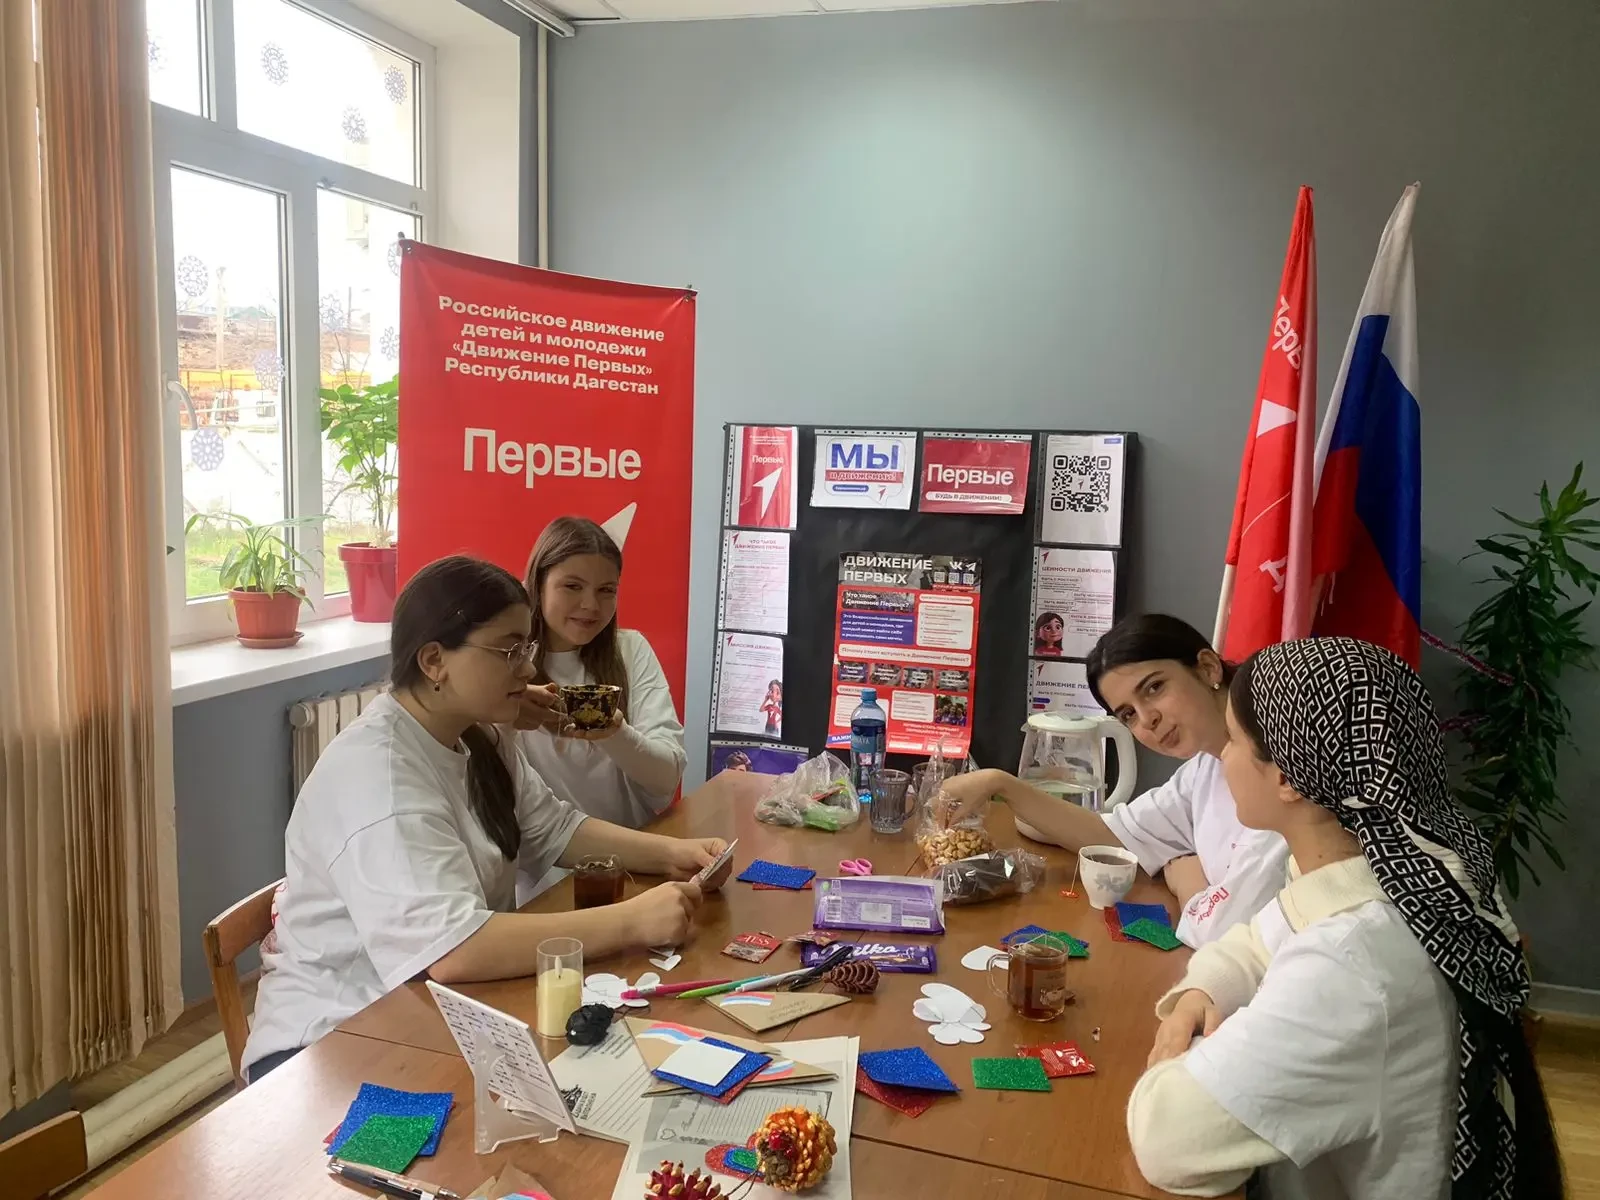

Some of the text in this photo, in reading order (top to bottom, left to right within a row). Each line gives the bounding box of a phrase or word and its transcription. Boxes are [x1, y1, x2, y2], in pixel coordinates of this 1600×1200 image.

[438, 295, 665, 342] Российское движение
[461, 323, 647, 357] детей и молодежи
[452, 340, 653, 376] «Движение Первых»
[444, 357, 659, 395] Республики Дагестан
[463, 427, 641, 489] Первые
[752, 454, 784, 465] Первые
[831, 443, 899, 470] МЫ
[927, 463, 1014, 489] Первые
[844, 556, 933, 570] ДВИЖЕНИЕ
[844, 570, 908, 584] ПЕРВЫХ
[846, 598, 909, 608] Движение Первых?
